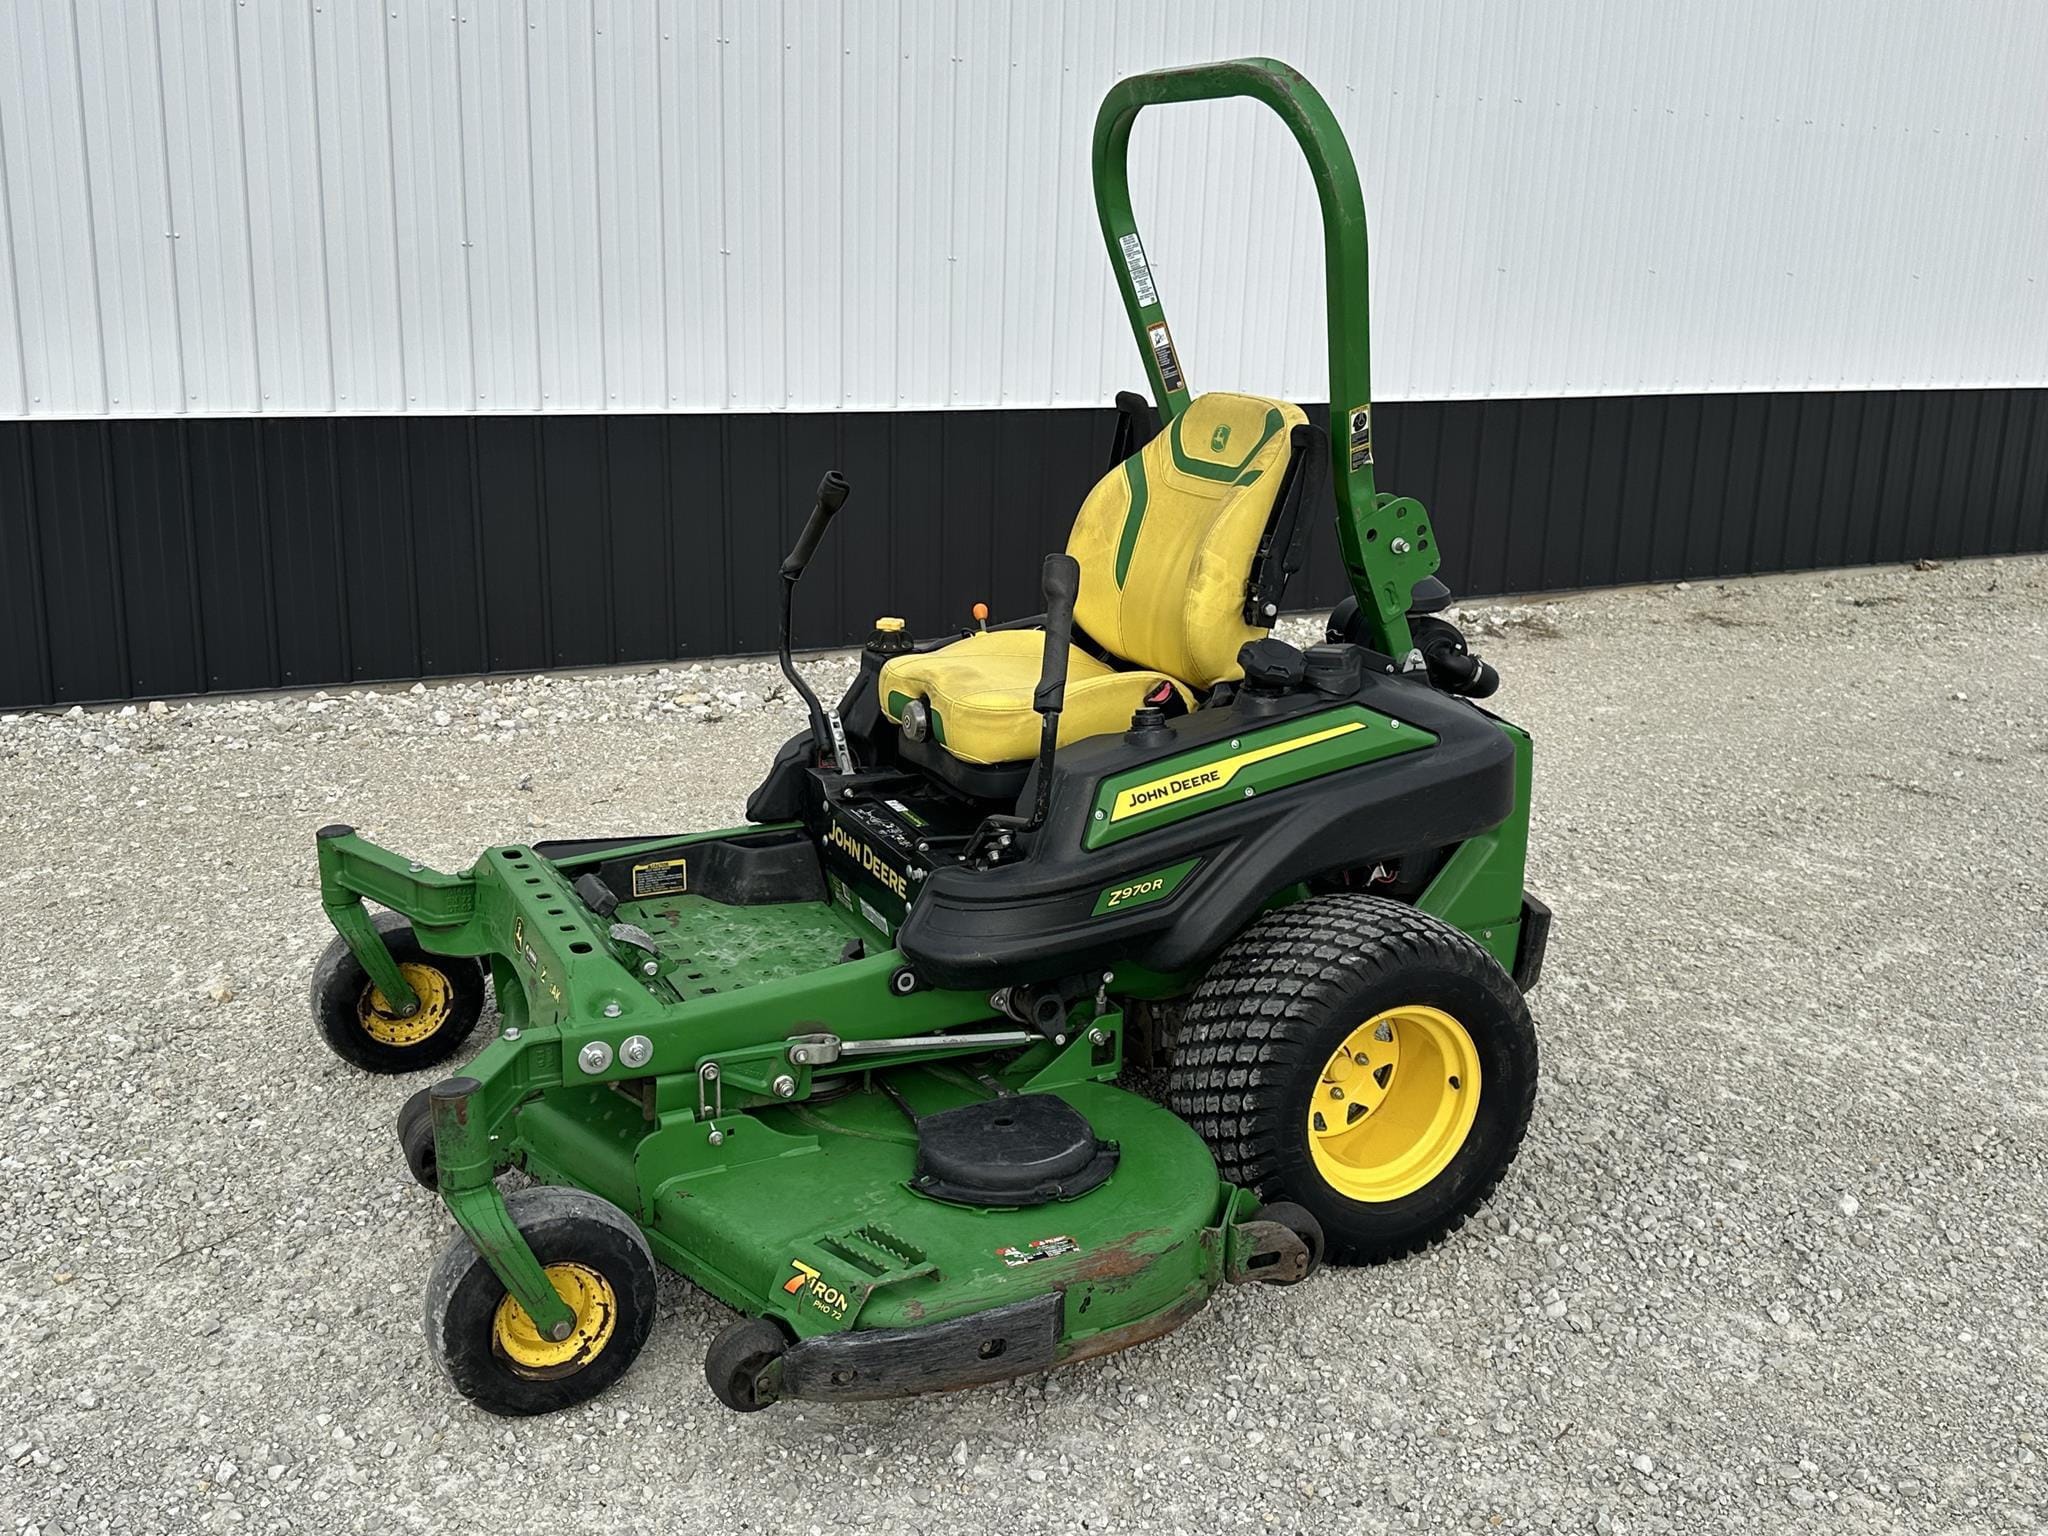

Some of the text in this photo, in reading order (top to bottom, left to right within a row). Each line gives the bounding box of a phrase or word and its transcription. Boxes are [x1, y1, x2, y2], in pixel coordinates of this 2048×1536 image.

[1129, 770, 1220, 807] JOHN DEERE
[828, 818, 860, 862] JOHN
[863, 843, 907, 900] DEERE
[1108, 879, 1163, 906] Z970R
[809, 1278, 848, 1311] IRON
[831, 1310, 842, 1320] 72
